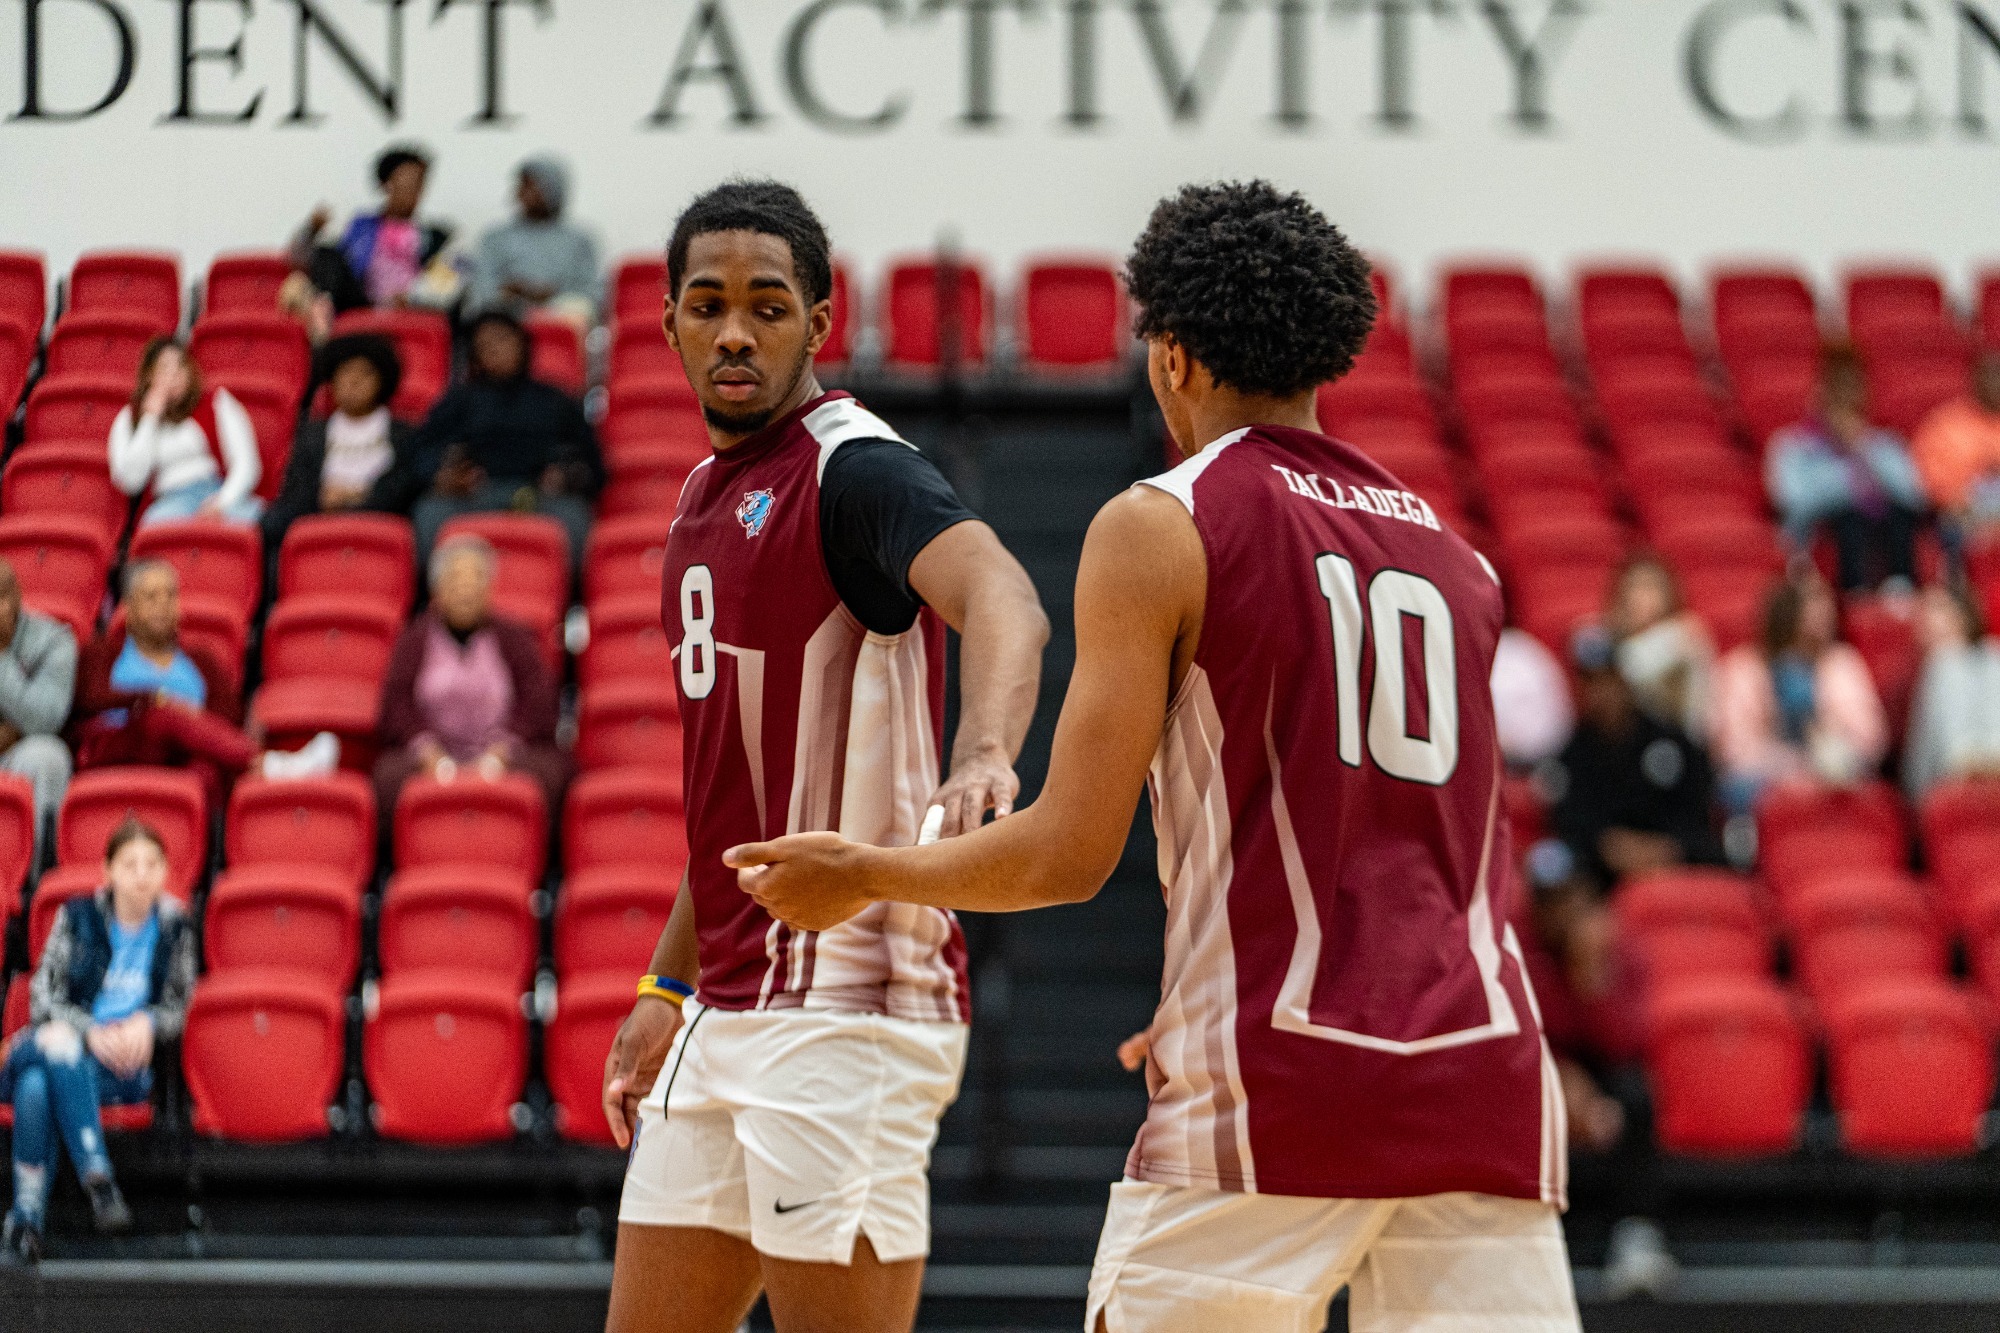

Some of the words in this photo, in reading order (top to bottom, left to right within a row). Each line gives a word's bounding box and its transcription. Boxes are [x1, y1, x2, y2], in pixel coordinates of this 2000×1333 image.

[638, 0, 1594, 136] ACTIVITY
[1270, 463, 1442, 532] TALLADEGA
[680, 563, 717, 700] 8
[1315, 551, 1459, 786] 10
